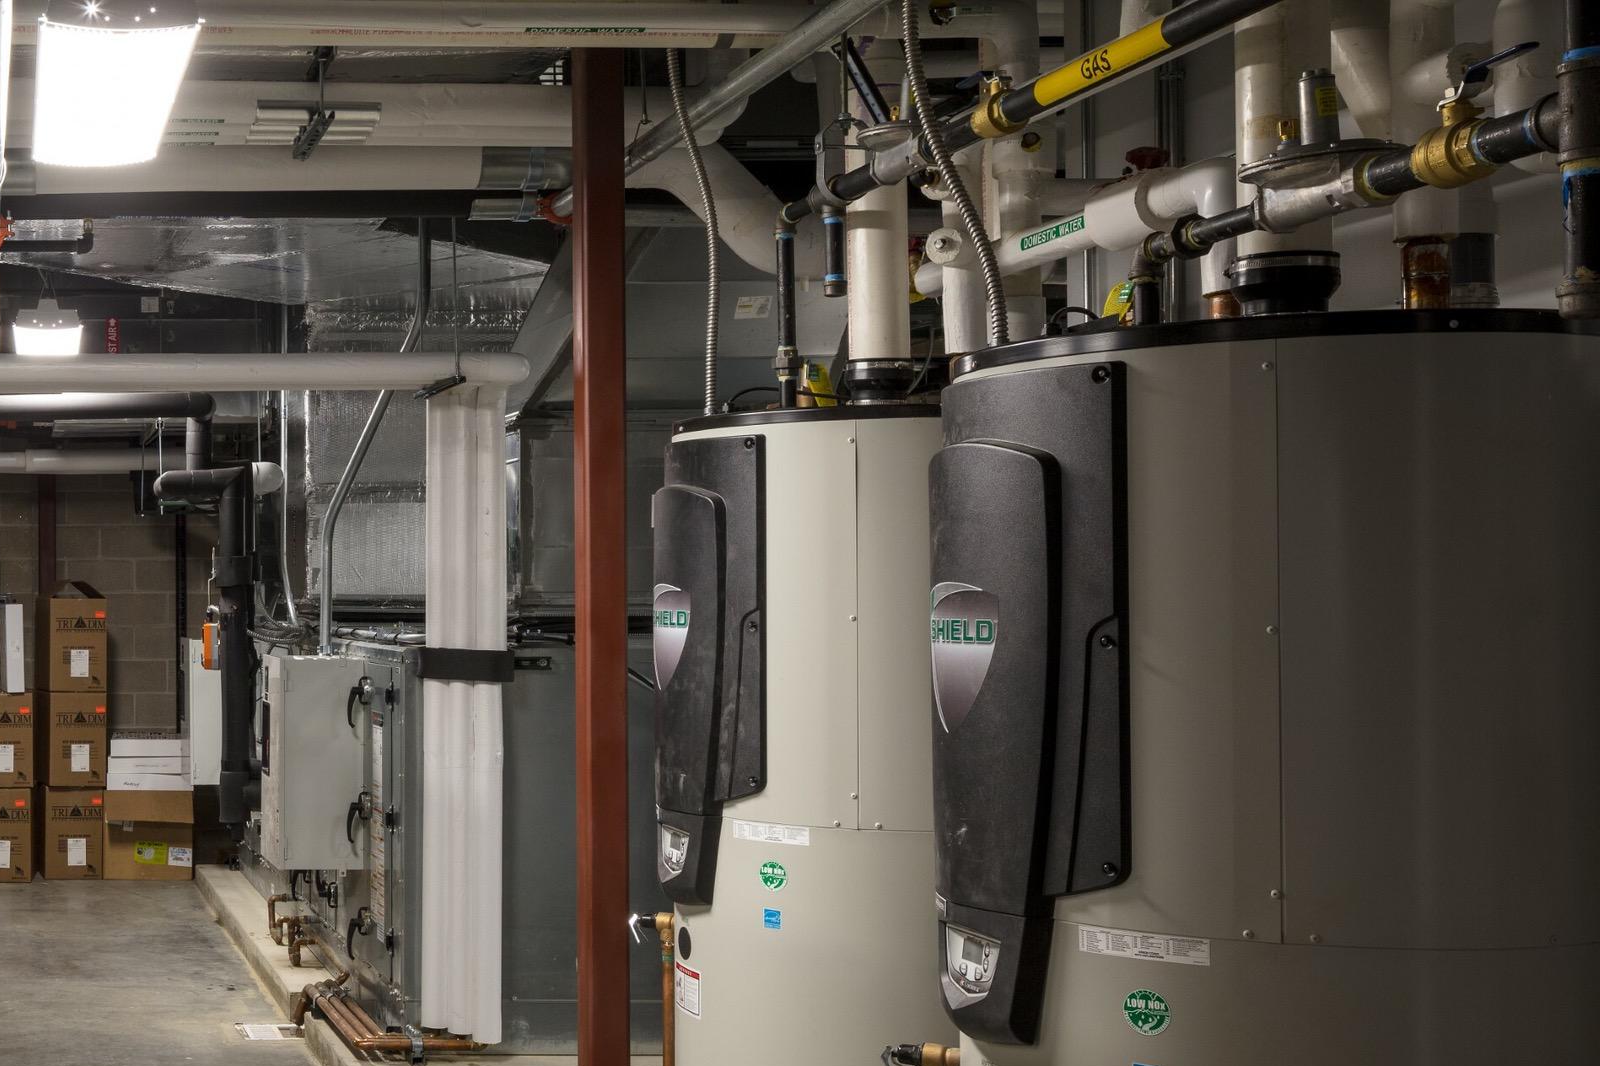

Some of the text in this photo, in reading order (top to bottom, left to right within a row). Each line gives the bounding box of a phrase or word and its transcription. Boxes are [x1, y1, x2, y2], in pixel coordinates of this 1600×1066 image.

[1080, 49, 1112, 80] GAS
[1023, 217, 1083, 249] DOMESTIC WATER
[108, 327, 117, 341] AIR
[655, 609, 688, 627] HIELD
[1127, 998, 1146, 1009] LOW
